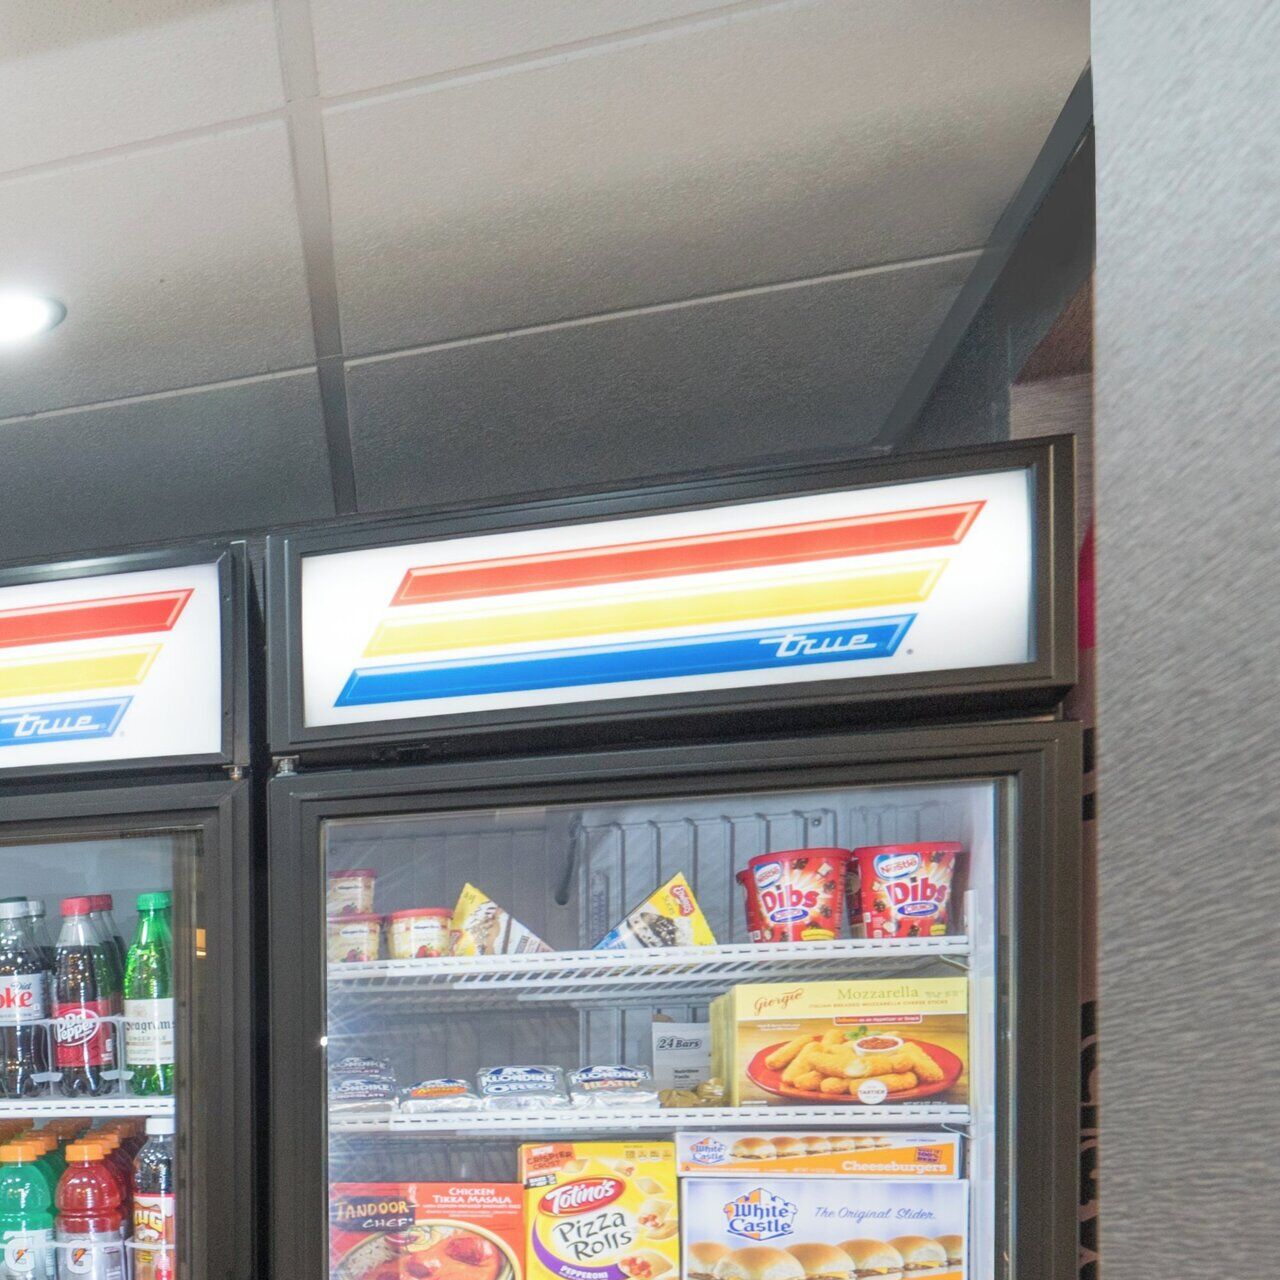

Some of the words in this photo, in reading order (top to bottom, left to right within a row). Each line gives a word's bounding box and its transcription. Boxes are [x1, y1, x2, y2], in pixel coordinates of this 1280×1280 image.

[759, 634, 877, 658] true
[0, 714, 100, 737] true
[762, 884, 820, 911] Dibs
[886, 877, 947, 904] Dibs
[754, 988, 805, 1016] Giorgio
[838, 986, 919, 1000] Mozzarella
[481, 1074, 555, 1085] KLONDIKE
[572, 1070, 650, 1082] KLONDIKE
[842, 1160, 947, 1174] Cheeseburgers
[448, 1188, 495, 1197] CHICKEN
[546, 1176, 615, 1213] Totino's
[334, 1200, 410, 1220] TANDOOR
[734, 1203, 788, 1220] White
[555, 1211, 627, 1243] Pizza
[729, 1216, 792, 1234] Castle
[571, 1230, 633, 1262] Rolls
[560, 1264, 609, 1280] PEPPERONI
